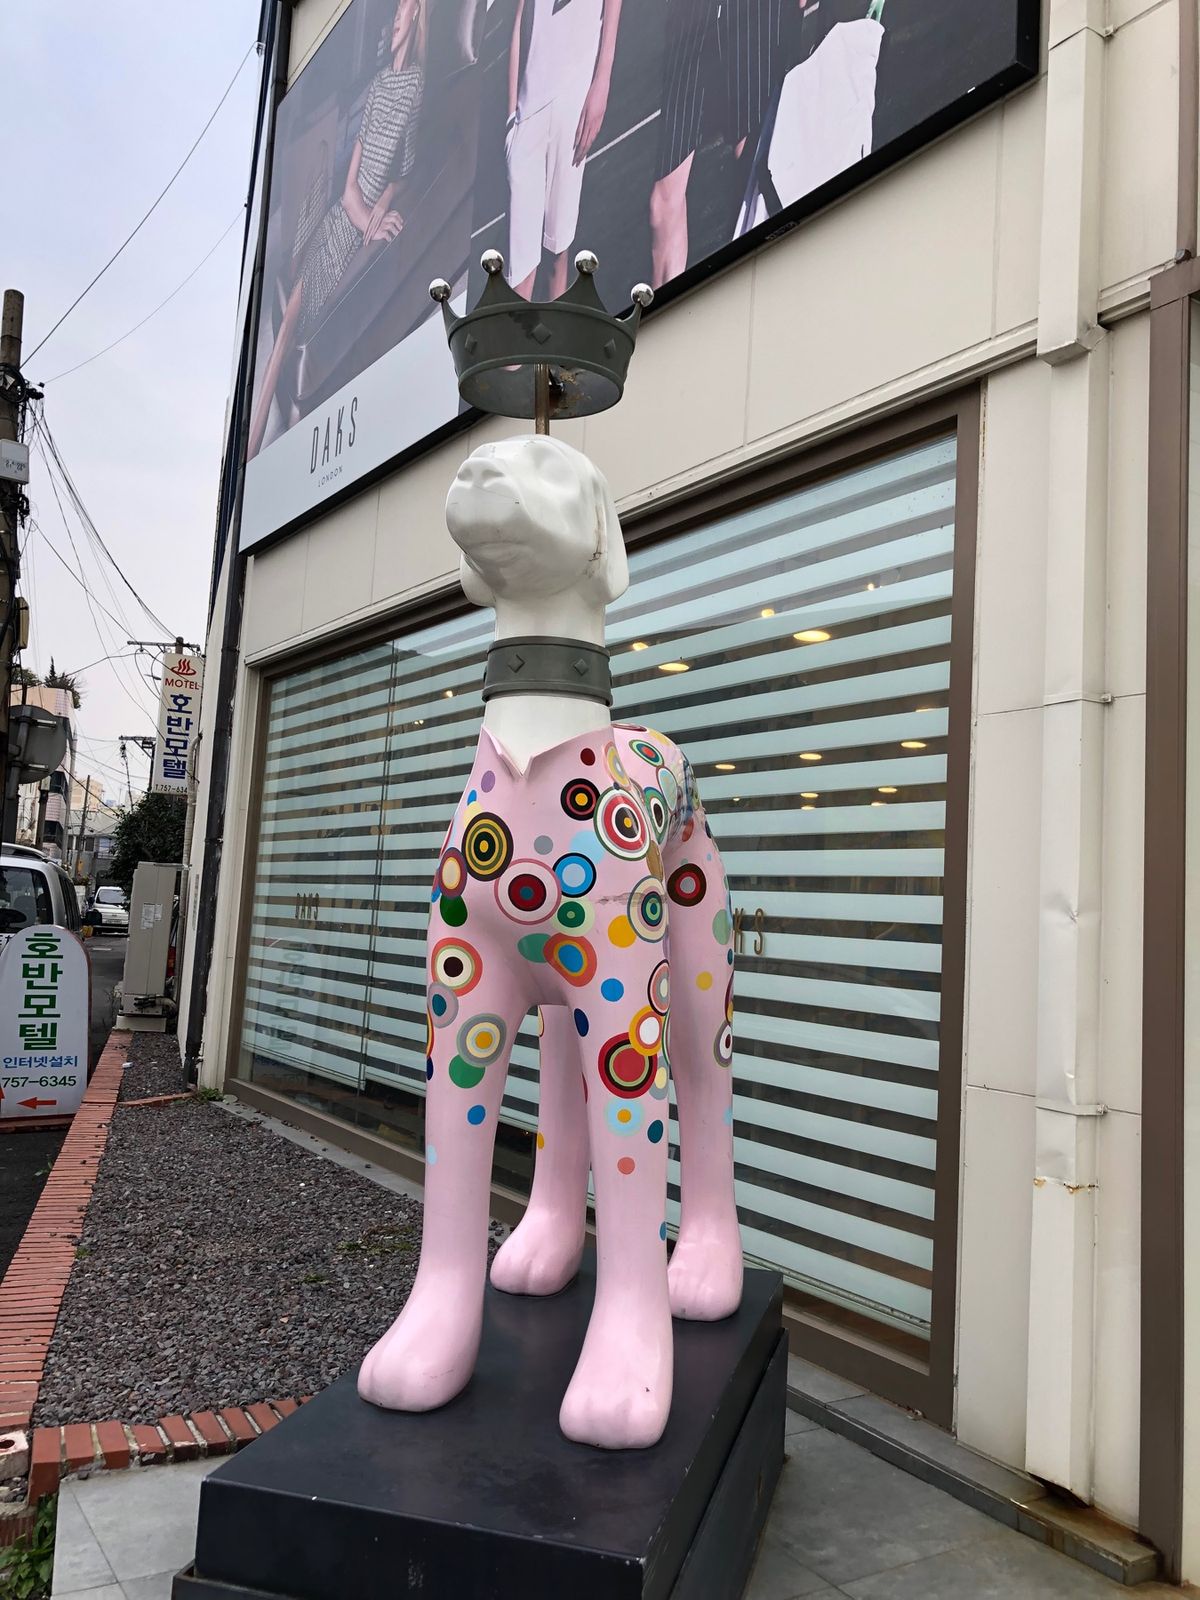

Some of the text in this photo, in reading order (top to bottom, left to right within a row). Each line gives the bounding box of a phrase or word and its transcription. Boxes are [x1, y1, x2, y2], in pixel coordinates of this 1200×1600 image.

[310, 396, 358, 474] DAKS
[165, 678, 200, 690] MOTEL
[163, 694, 193, 779] 호반모텔
[155, 784, 188, 794] T.757-634
[733, 907, 764, 955] KS
[18, 933, 64, 1051] 호반모텔
[3, 1056, 78, 1069] 인터넷설치
[2, 1075, 77, 1088] 757-6345
